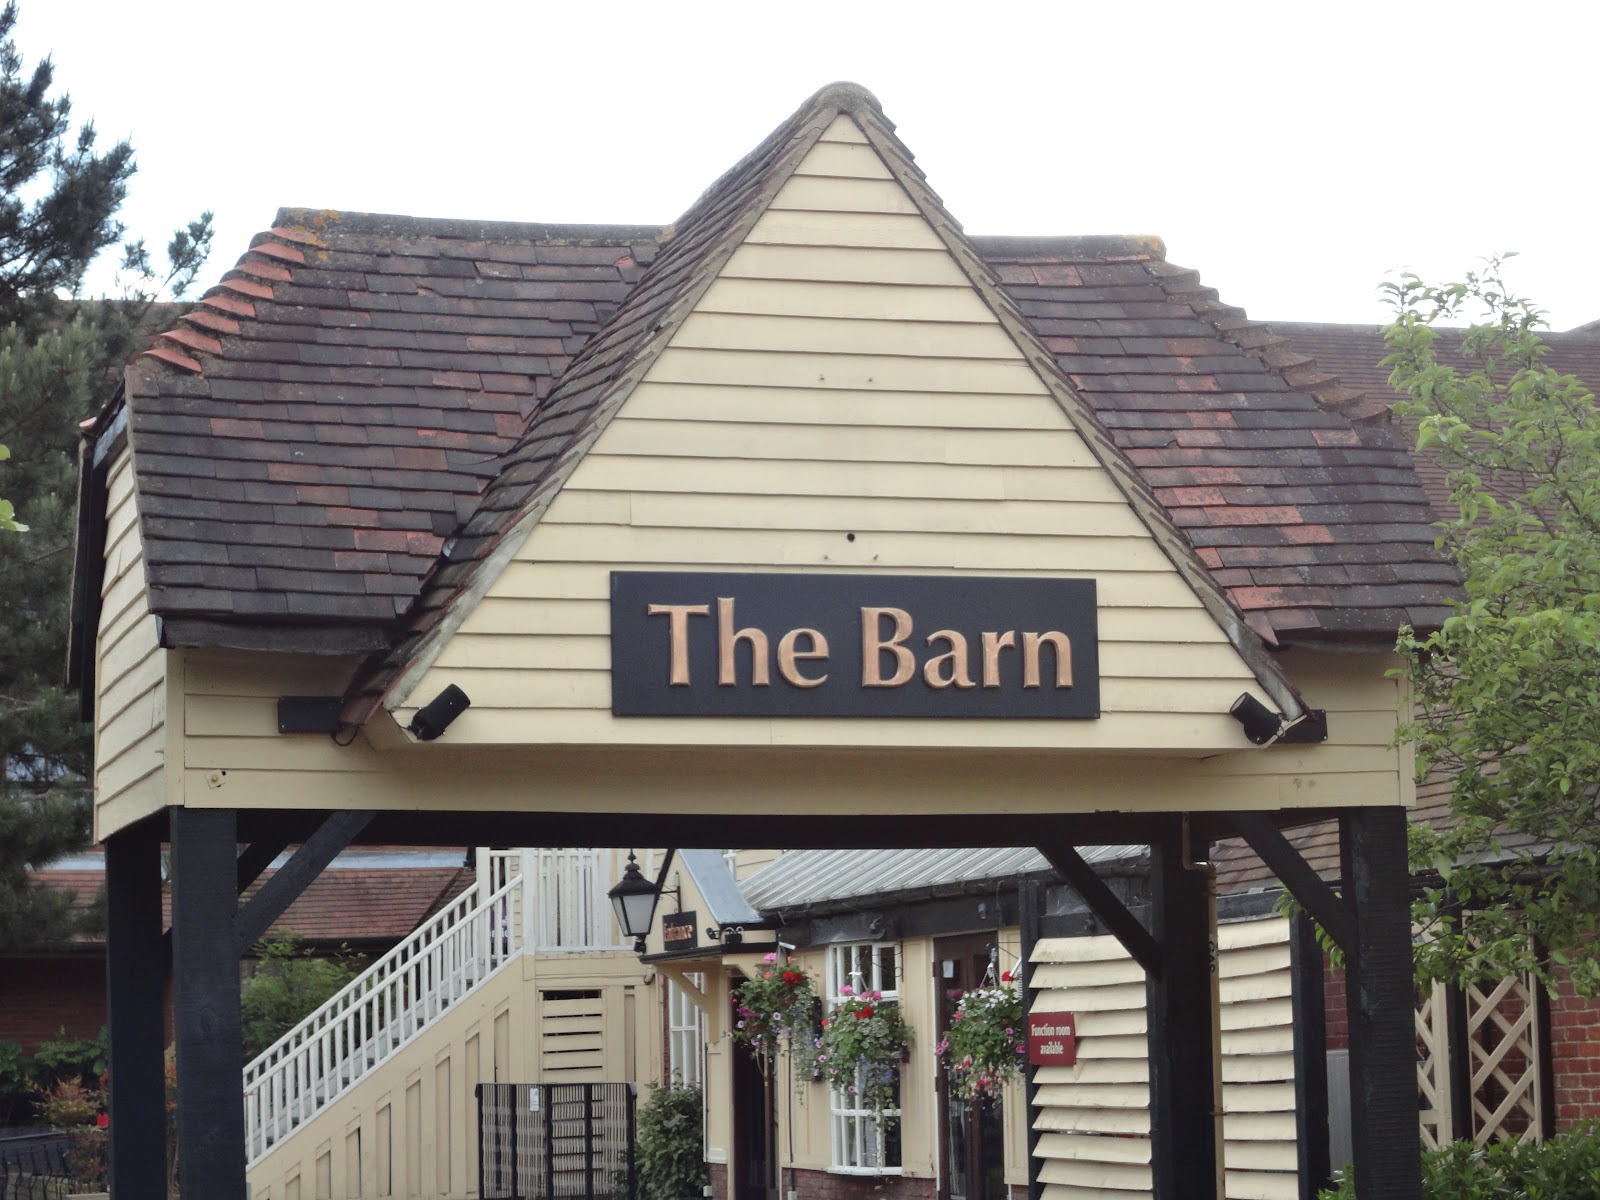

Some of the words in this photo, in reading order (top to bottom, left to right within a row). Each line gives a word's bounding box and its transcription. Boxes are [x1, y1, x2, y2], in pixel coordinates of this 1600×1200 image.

[647, 597, 830, 688] The
[859, 606, 1074, 690] Barn
[1031, 1023, 1055, 1036] Function
[1056, 1026, 1071, 1036] room
[1040, 1041, 1064, 1055] available
